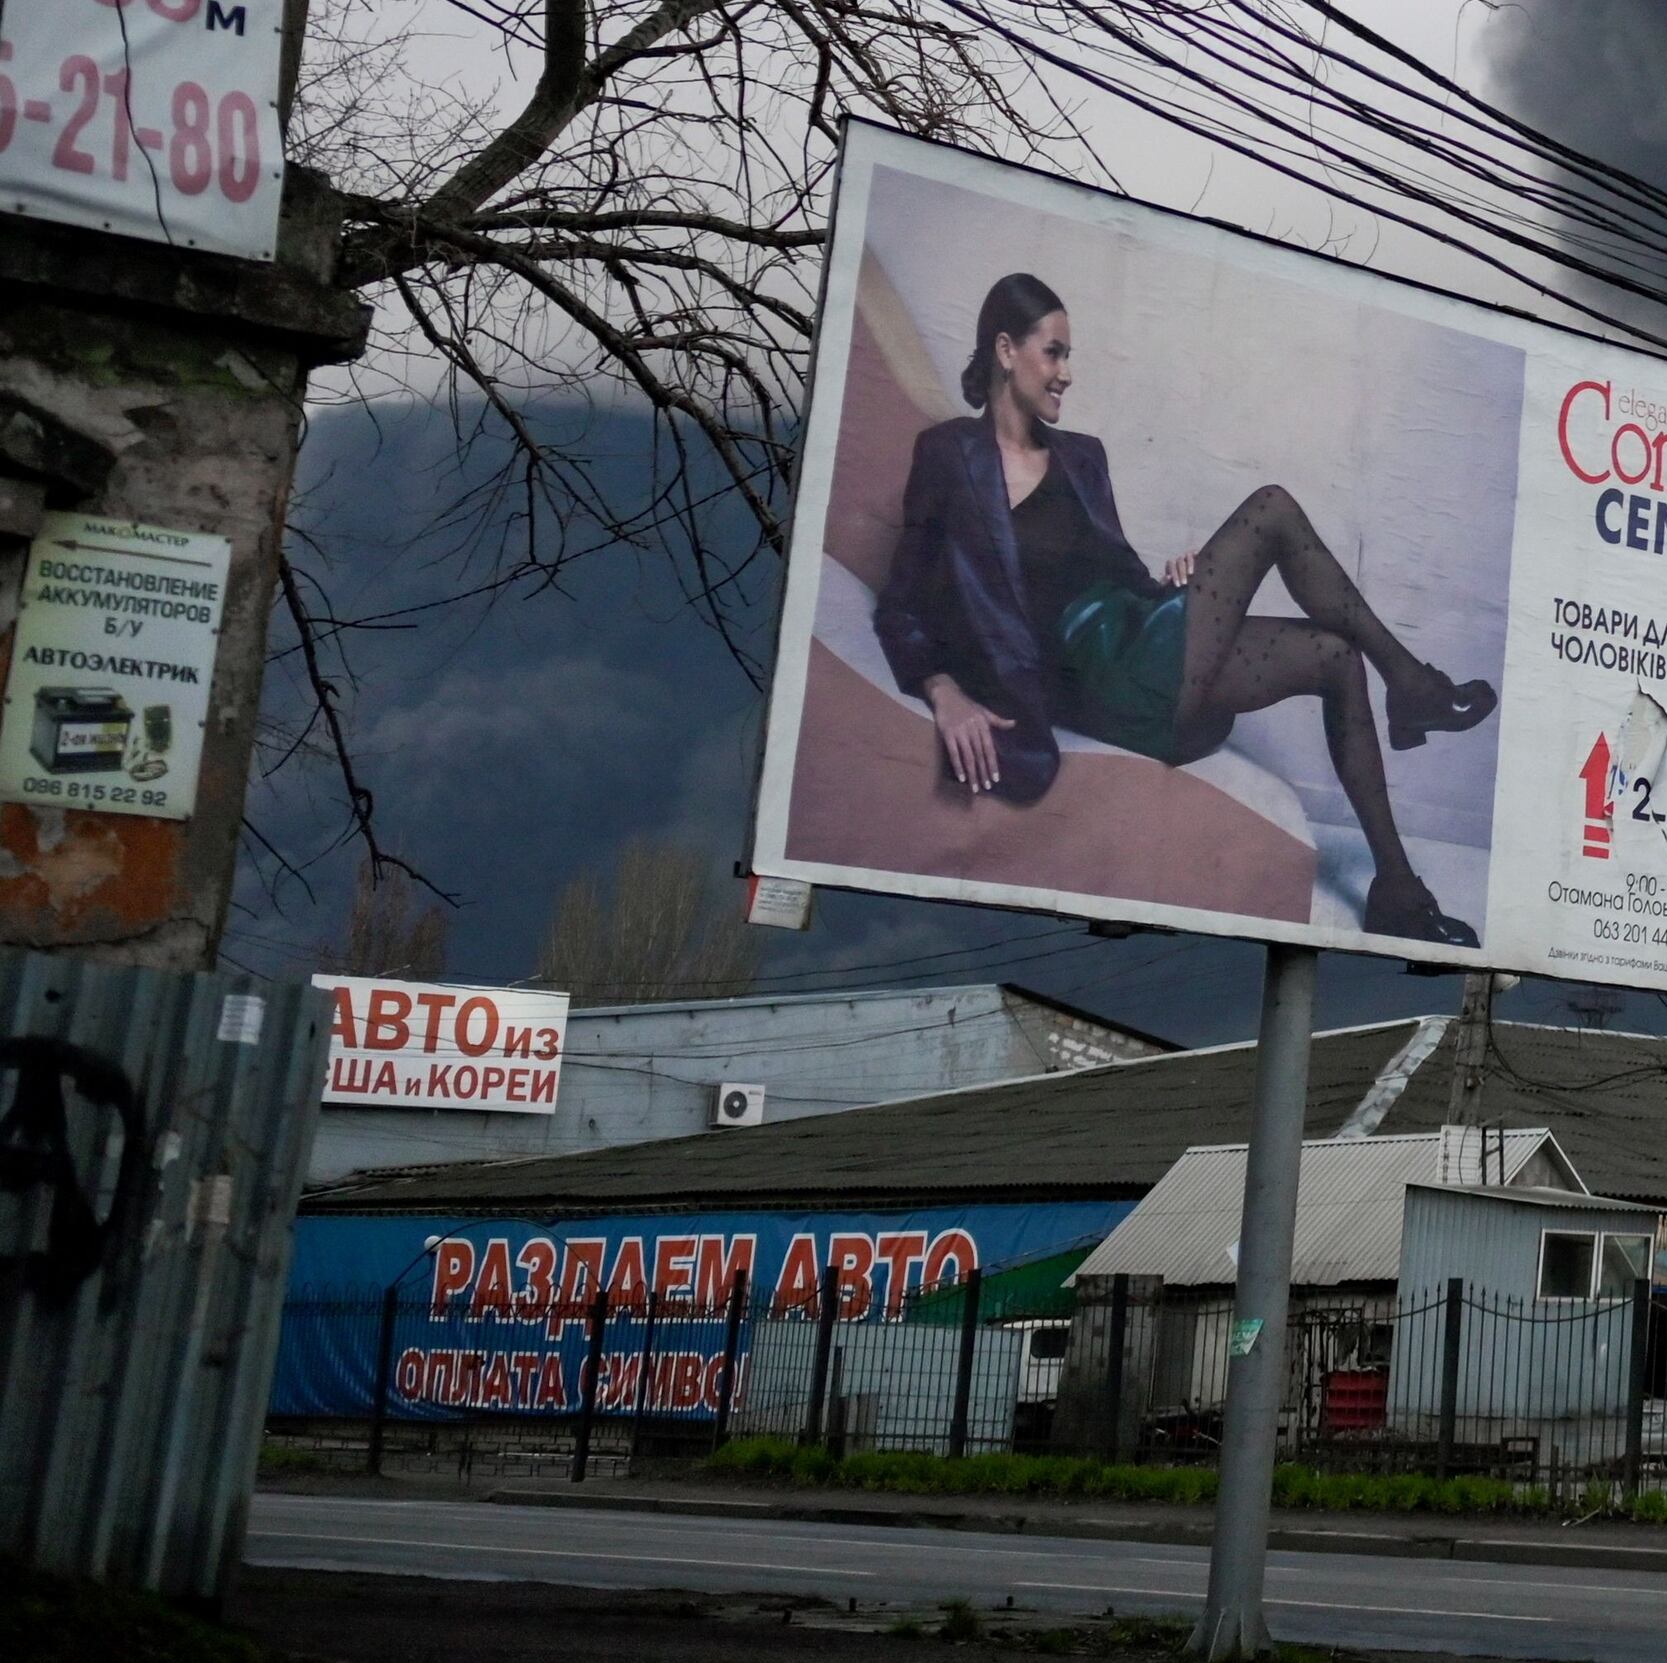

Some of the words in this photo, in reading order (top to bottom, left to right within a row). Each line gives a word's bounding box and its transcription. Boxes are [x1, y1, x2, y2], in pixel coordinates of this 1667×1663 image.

[38, 560, 218, 602] ВОССТАНОВЛЕНИЕ
[37, 584, 212, 624] АККУМУЛЯТОРОВ
[1554, 597, 1638, 640] ТОВАРИ
[103, 616, 144, 637] Б/У
[22, 645, 199, 684] АВТОЭЛЕКТРИК
[1551, 632, 1667, 681] ЧОЛОВІКІВ
[1548, 880, 1624, 911] Отамана
[1593, 918, 1620, 940] 063
[1623, 922, 1648, 945] 201
[330, 986, 500, 1057] АВТО
[427, 1064, 557, 1104] КОРЕИ
[429, 1234, 757, 1342] РАЗДАЕМ
[769, 1228, 979, 1324] АВТО
[395, 1347, 568, 1411] ОПЛАТА
[577, 1350, 750, 1414] СИМВО
